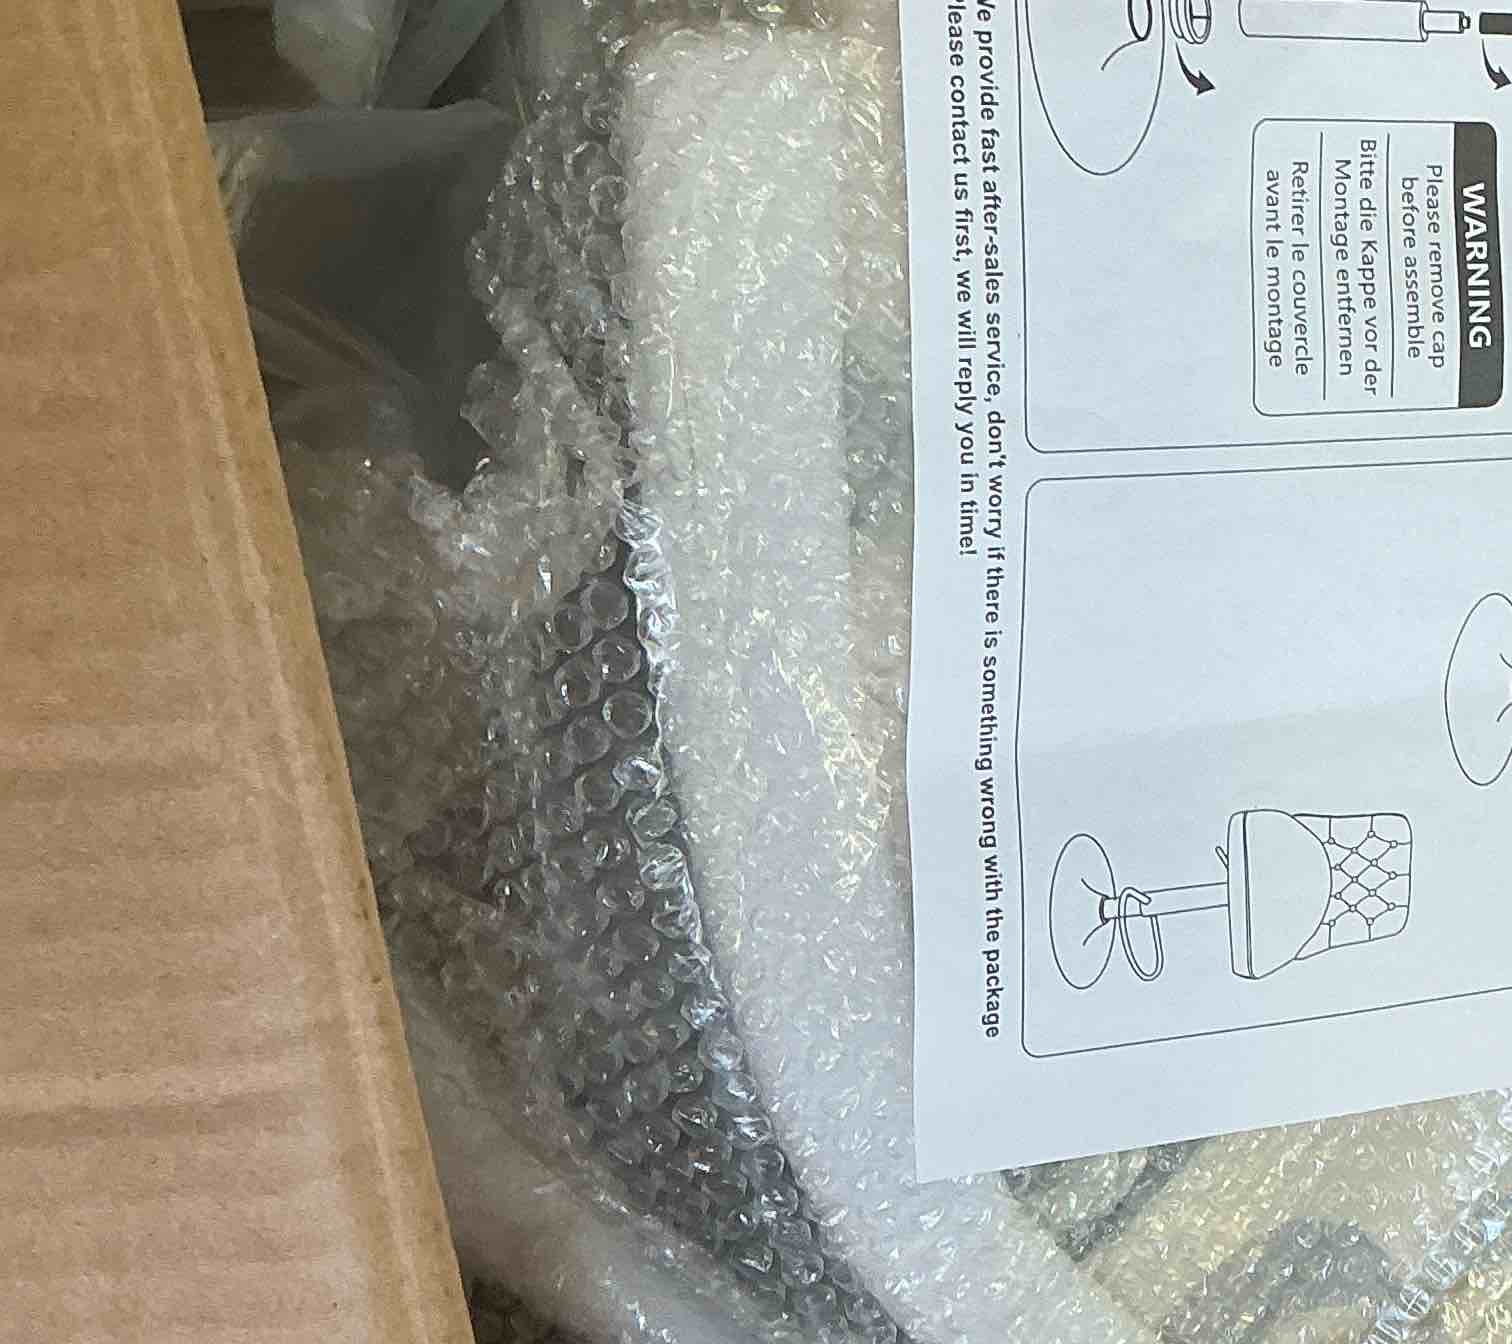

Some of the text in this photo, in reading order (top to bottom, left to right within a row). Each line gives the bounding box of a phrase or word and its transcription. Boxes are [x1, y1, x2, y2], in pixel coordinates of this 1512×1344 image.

[973, 30, 998, 121] provide
[949, 75, 970, 165] contact
[980, 128, 1000, 173] fast
[953, 173, 969, 201] us
[951, 208, 973, 263] first,
[981, 180, 1003, 305] after-sales
[1461, 182, 1491, 349] WARNING
[954, 270, 971, 303] we
[1263, 170, 1283, 368] avant le montage
[1291, 161, 1312, 376] Retirer le couvercle
[1329, 159, 1355, 376] Montage entfernen
[1356, 139, 1381, 396] Bitte die Kappe vor der
[1400, 177, 1423, 359] before assemble
[1425, 165, 1446, 369] Please remove cap
[956, 309, 976, 349] will
[983, 312, 1005, 403] service,
[953, 357, 976, 415] reply
[954, 422, 974, 465] you
[986, 411, 1005, 468] don't
[959, 473, 978, 492] in
[983, 476, 1003, 538] worry
[958, 500, 977, 556] time!
[986, 546, 1004, 560] if
[983, 566, 1003, 624] there
[983, 630, 1002, 648] is
[974, 656, 997, 771] something
[977, 777, 997, 848] wrong
[983, 855, 1002, 901] with
[985, 908, 1002, 942] the
[981, 949, 1002, 1038] package
